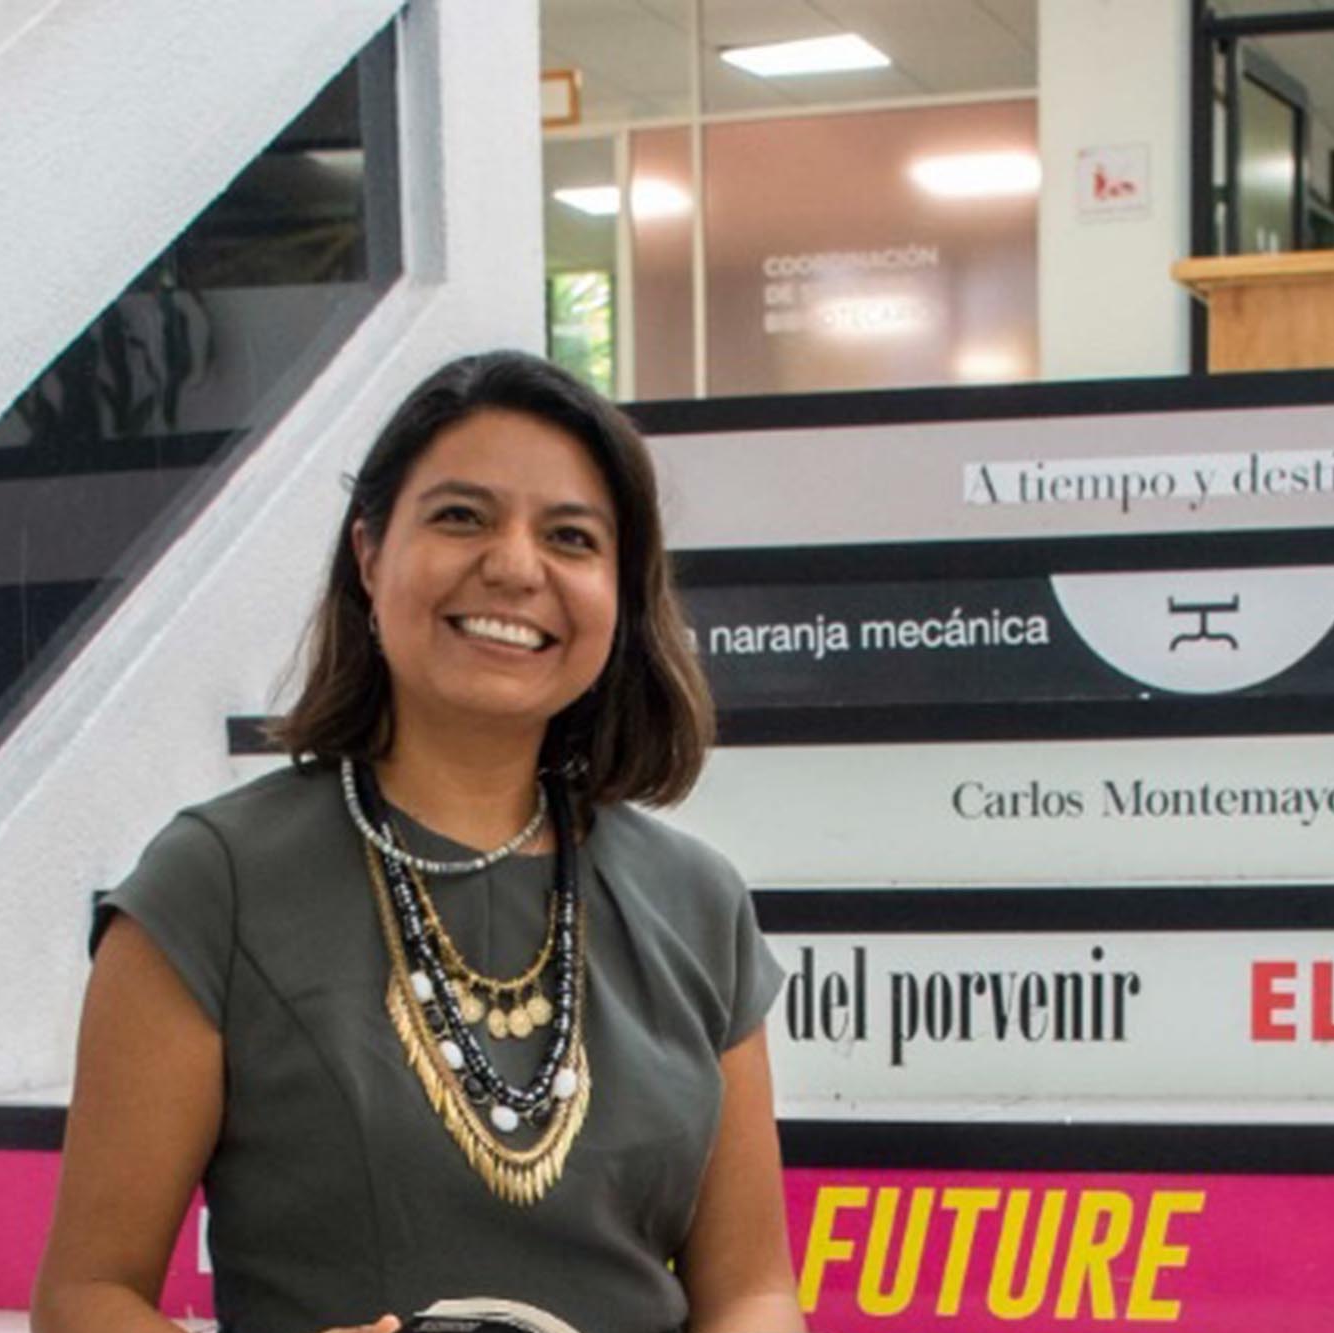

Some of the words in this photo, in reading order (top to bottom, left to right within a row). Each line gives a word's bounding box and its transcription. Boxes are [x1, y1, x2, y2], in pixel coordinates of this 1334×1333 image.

[970, 464, 999, 504] A
[1019, 462, 1176, 513] tiempo
[1189, 469, 1217, 510] y
[710, 618, 849, 660] naranja
[861, 607, 1049, 651] mecánica
[951, 780, 1084, 819] Carlos
[785, 946, 868, 1042] del
[888, 946, 1141, 1067] porvenir
[797, 1186, 1207, 1322] FUTURE
